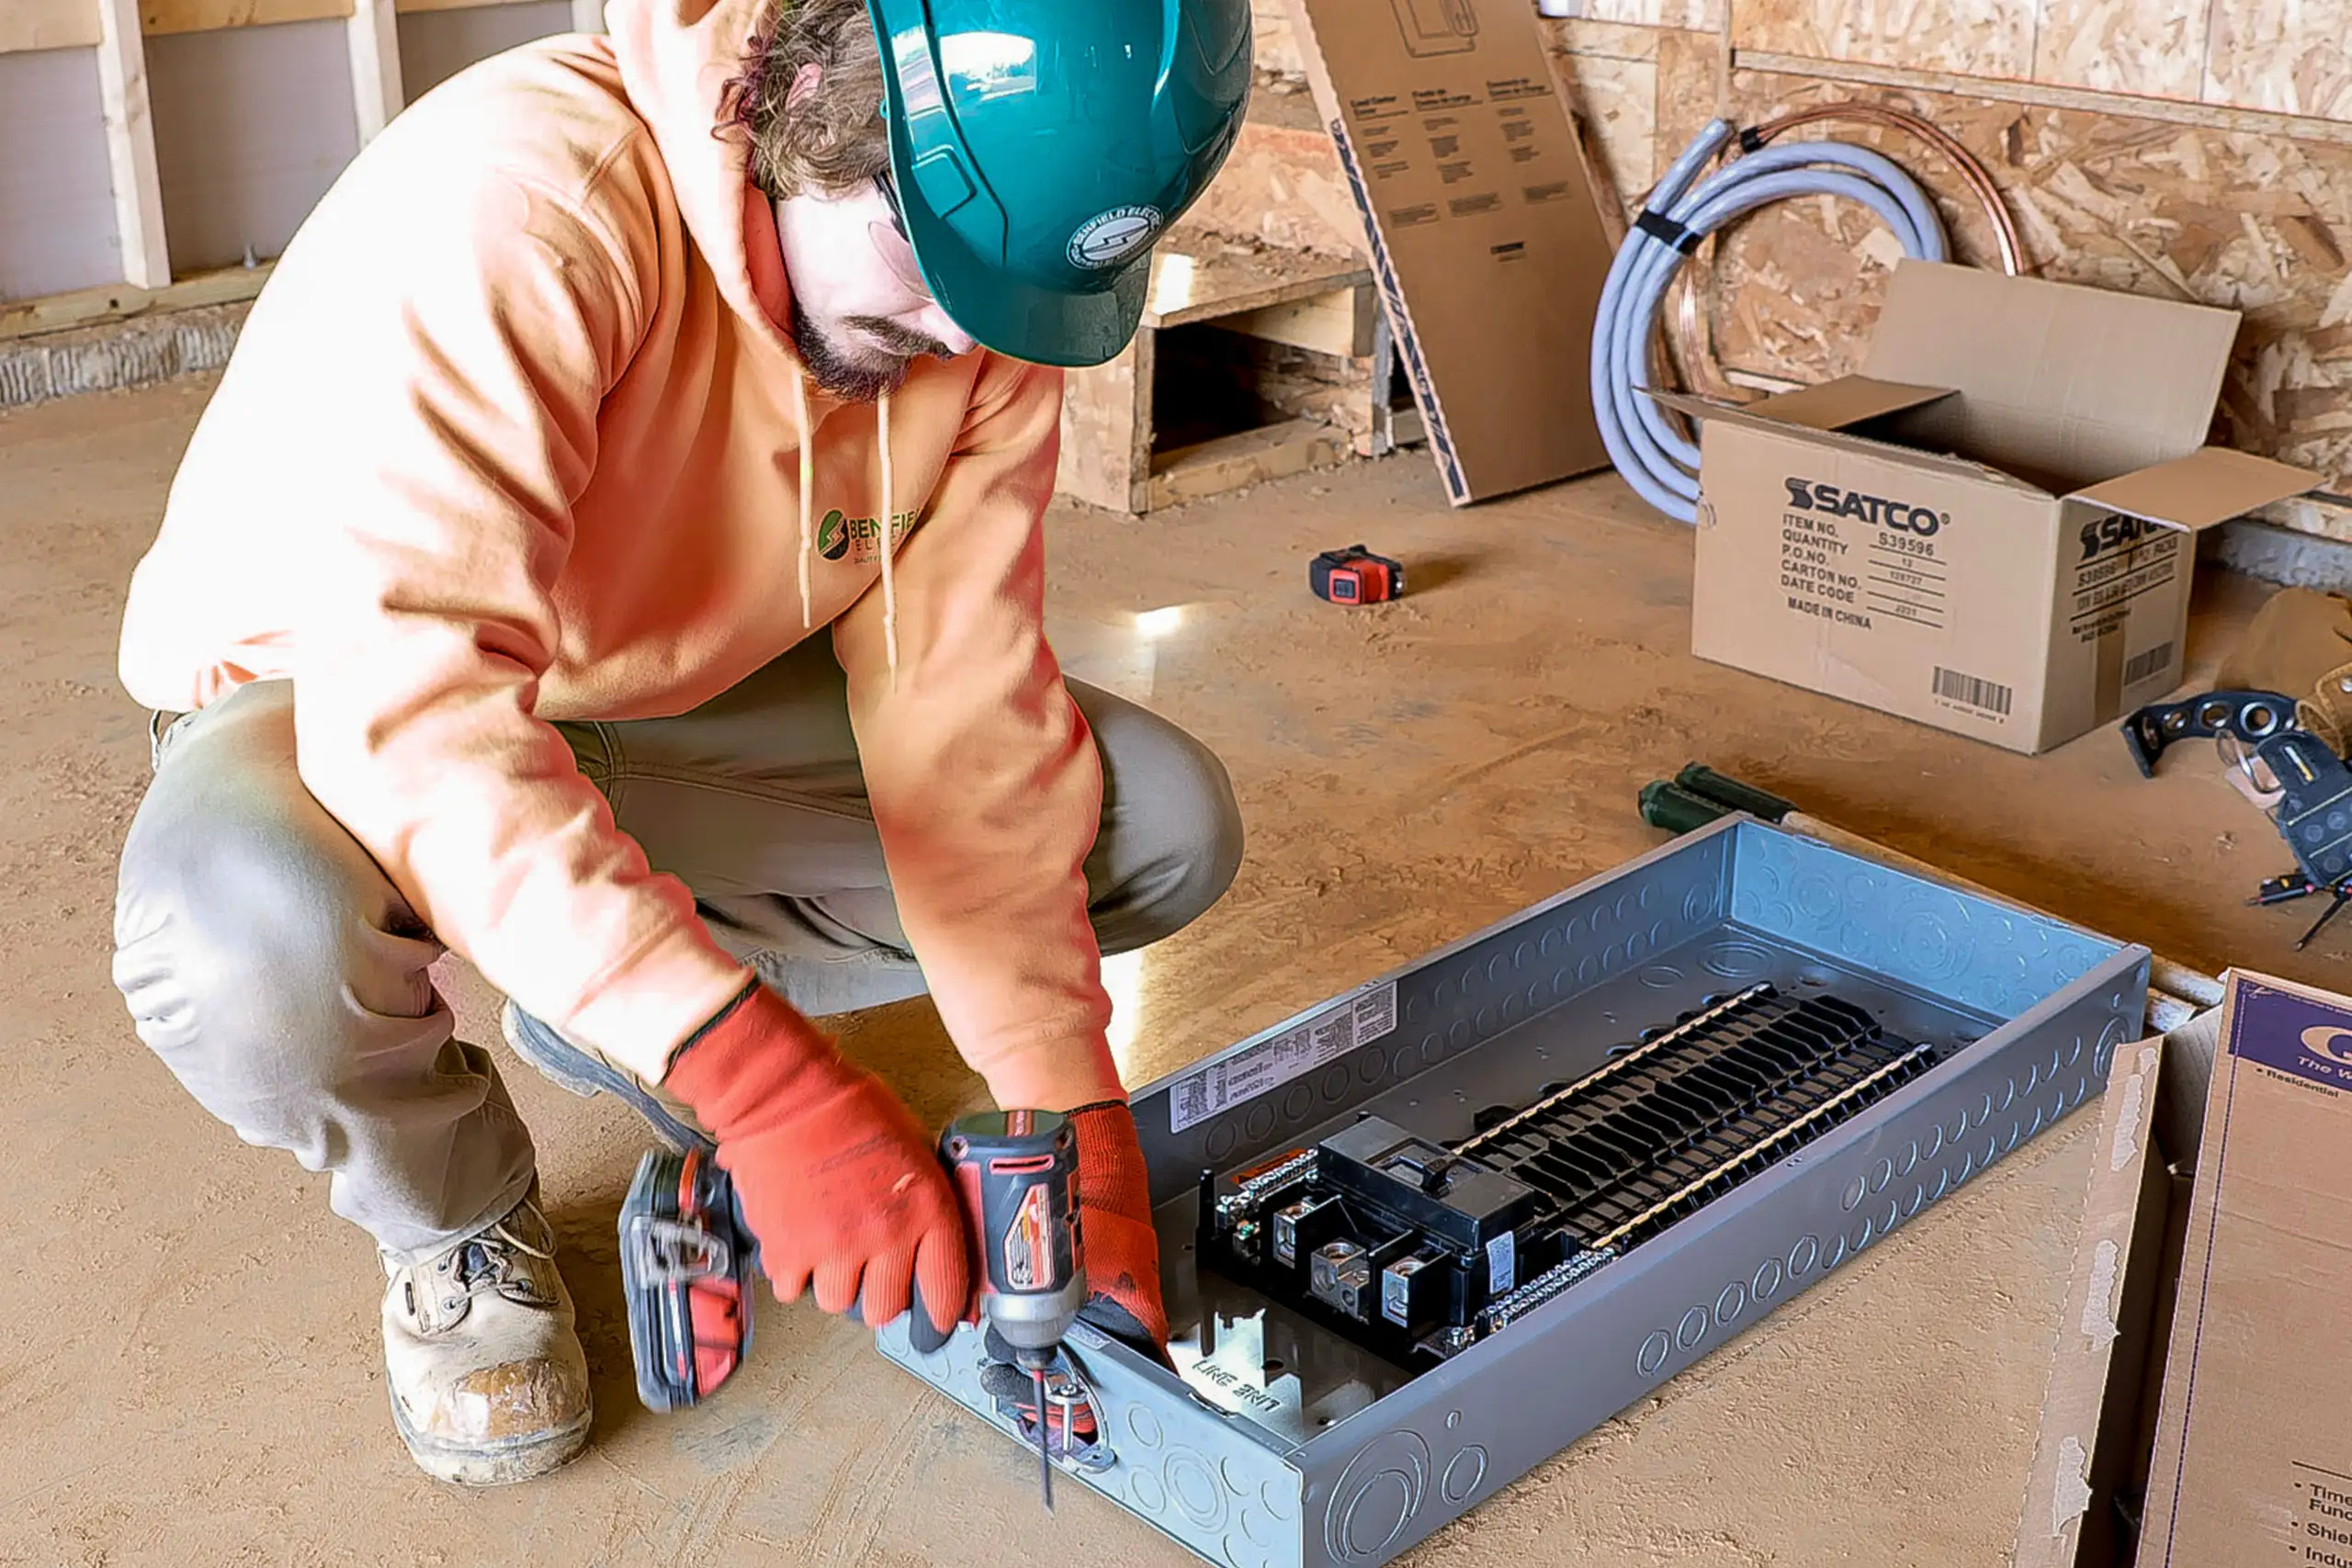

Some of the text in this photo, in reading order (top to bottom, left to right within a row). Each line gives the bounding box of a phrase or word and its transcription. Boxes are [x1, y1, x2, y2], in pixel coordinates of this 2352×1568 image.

[1814, 484, 1939, 536] SATCO
[1782, 513, 1839, 538] ITEM NO.
[1781, 528, 1849, 556] QUANTITY
[1878, 532, 1935, 557] S39596
[1781, 558, 1862, 591] CARTON NO.
[1781, 574, 1855, 604] DATE CODE
[1788, 596, 1872, 630] MADE IN CHINA
[2298, 1055, 2333, 1075] The
[2266, 1069, 2339, 1099] Residential
